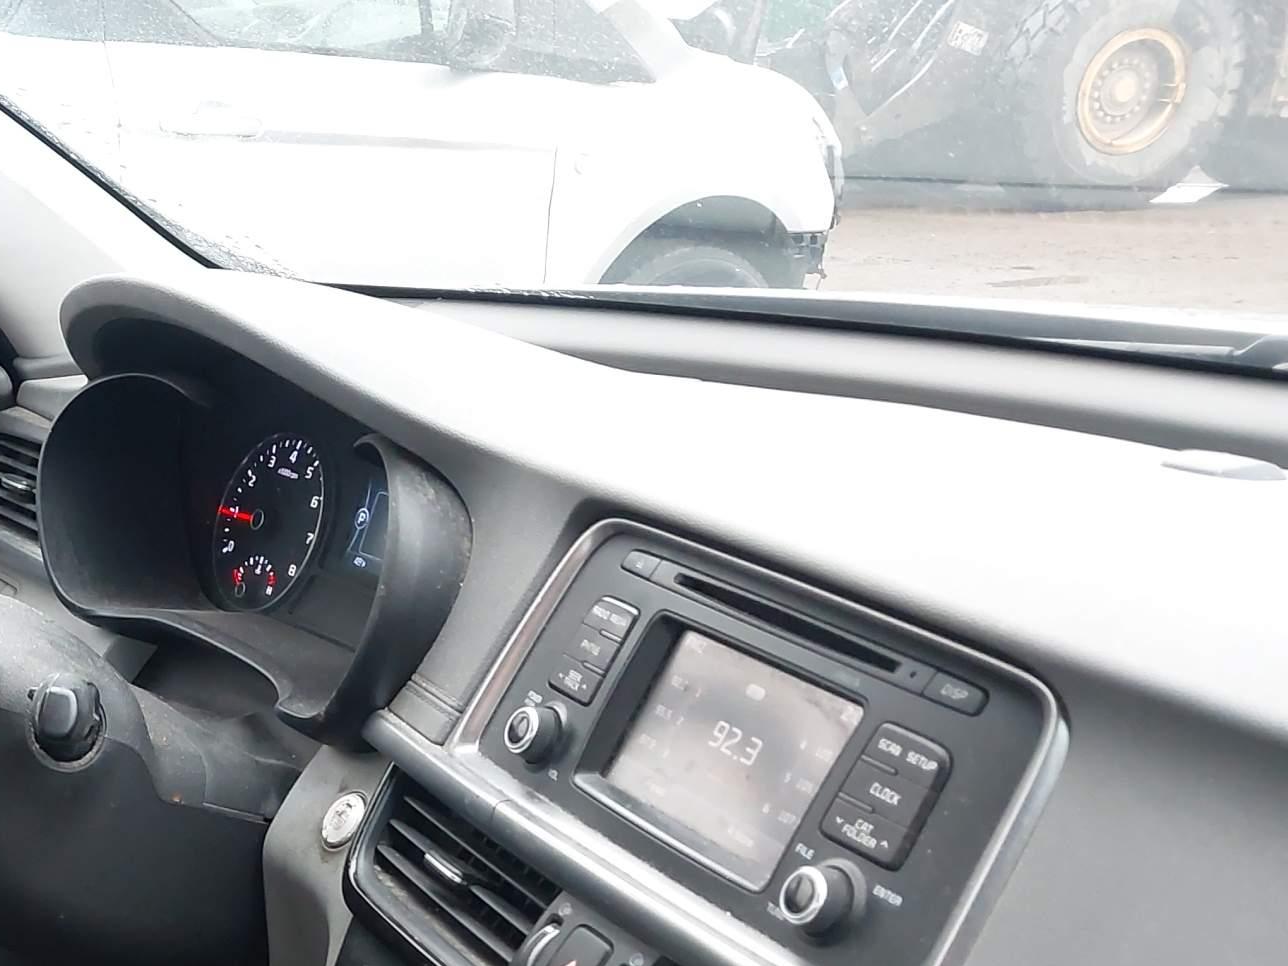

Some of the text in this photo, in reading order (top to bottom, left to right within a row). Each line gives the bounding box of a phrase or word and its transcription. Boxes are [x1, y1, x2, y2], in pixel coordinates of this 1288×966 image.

[267, 455, 276, 468] 3
[289, 450, 298, 463] 4
[305, 466, 314, 479] 5
[248, 475, 257, 487] 2
[310, 495, 319, 508] 6
[357, 513, 366, 524] P
[305, 532, 314, 544] 7
[287, 564, 297, 577] 8
[940, 683, 968, 700] DISP
[707, 720, 763, 766] 92.3
[877, 738, 938, 771] SCAN SETUP
[869, 782, 902, 807] CLOCK
[854, 819, 875, 832] CAT
[841, 824, 878, 849] FOLDER
[794, 843, 815, 860] FILE
[871, 884, 904, 907] ENTER
